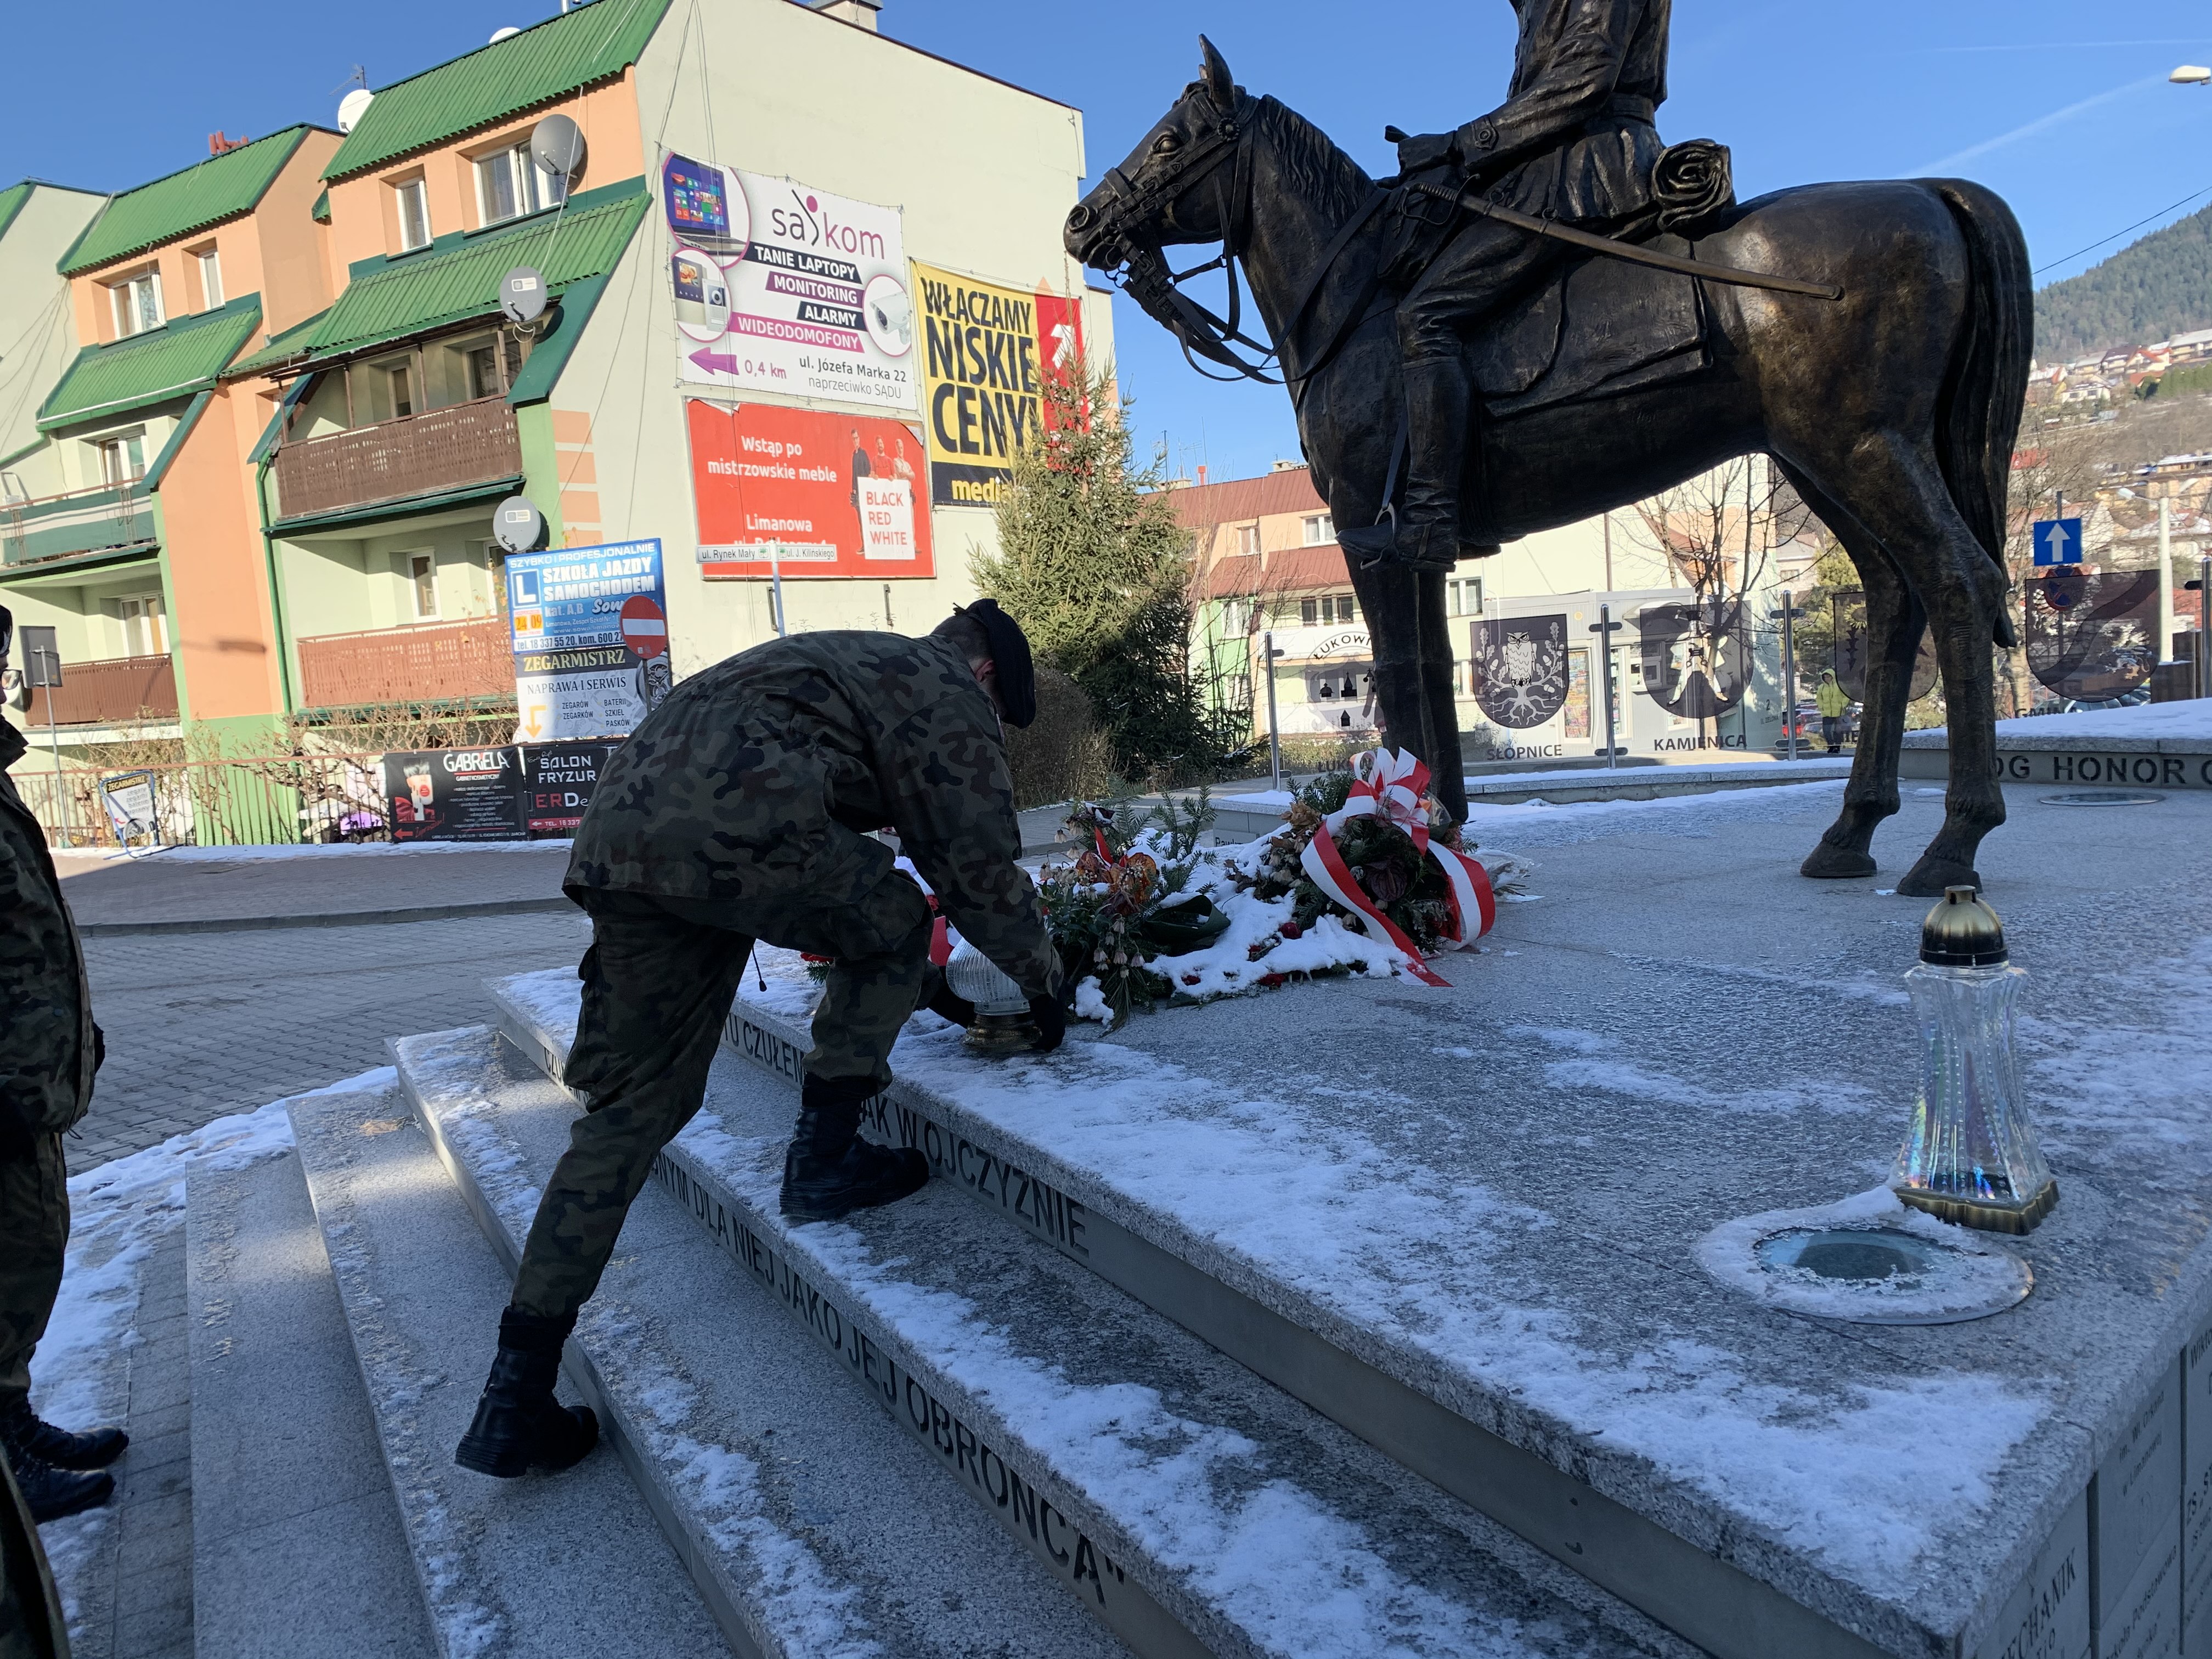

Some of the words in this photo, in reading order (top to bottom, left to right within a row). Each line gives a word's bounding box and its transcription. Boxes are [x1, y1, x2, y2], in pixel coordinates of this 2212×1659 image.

[754, 245, 795, 268] TANIE
[798, 254, 855, 280] LAPTOPY
[774, 274, 858, 304] MONITORING
[804, 304, 857, 327] ALARMY
[921, 276, 1031, 335] WŁĄCZAMY
[737, 316, 859, 349] WIDEODOMOFONY
[926, 314, 1037, 394] NISKIE
[744, 359, 766, 377] 0,4
[770, 362, 787, 380] km
[799, 357, 814, 370] ul.
[817, 358, 854, 375] Józefa
[856, 364, 890, 380] Marka
[893, 370, 907, 383] 22
[808, 375, 872, 397] naprzeciwko
[874, 380, 902, 399] SĄDU
[741, 435, 783, 458] Wstąp
[786, 442, 803, 459] po
[708, 458, 796, 480] mistrzowskie
[799, 466, 837, 483] meble
[866, 491, 904, 507] BLACK
[746, 514, 812, 533] Limanowa
[868, 511, 891, 526] RED
[870, 531, 908, 546] WHITE
[510, 555, 552, 569] SZYBKO
[558, 543, 655, 562] PROFESJONALNIE
[714, 549, 736, 561] Rynek
[738, 549, 755, 560] Mały
[803, 548, 834, 560] Kilińskiego
[542, 562, 600, 584] SZKOŁA
[602, 556, 652, 577] JAZDY
[516, 575, 537, 603] L
[543, 575, 656, 602] SAMOCHODEM
[544, 606, 565, 617] kat.
[518, 641, 529, 650] tel.
[530, 640, 538, 648] 18
[539, 637, 552, 647] 337
[555, 636, 564, 647] 55
[578, 634, 597, 645] kom.
[598, 632, 613, 643] 600
[1313, 635, 1371, 660] ŁUKOWI
[523, 649, 626, 672] ZEGARMISTRZ
[527, 680, 578, 695] NAPRAWA
[580, 680, 584, 690] I
[586, 676, 627, 690] SERWIS
[562, 700, 589, 709] ZEGARÓW
[604, 698, 626, 706] BATERII
[1766, 699, 1770, 710] 2
[563, 710, 594, 720] ZEGARKÓW
[606, 718, 630, 727] PASKÓW
[1487, 744, 1562, 761] SŁOPNICE
[1654, 735, 1747, 751] KAMIENICA
[540, 755, 591, 771] SALON
[2053, 756, 2187, 785] HONOR
[107, 775, 145, 791] ZEGARMISTRZ
[535, 792, 591, 808] ERDe
[895, 1103, 917, 1149] W
[692, 1180, 730, 1246] DLA
[732, 1215, 775, 1287] NIEJ
[780, 1262, 842, 1350] JAKO
[847, 1325, 898, 1406] JEJ
[2002, 1546, 2076, 1659] ECHANIK
